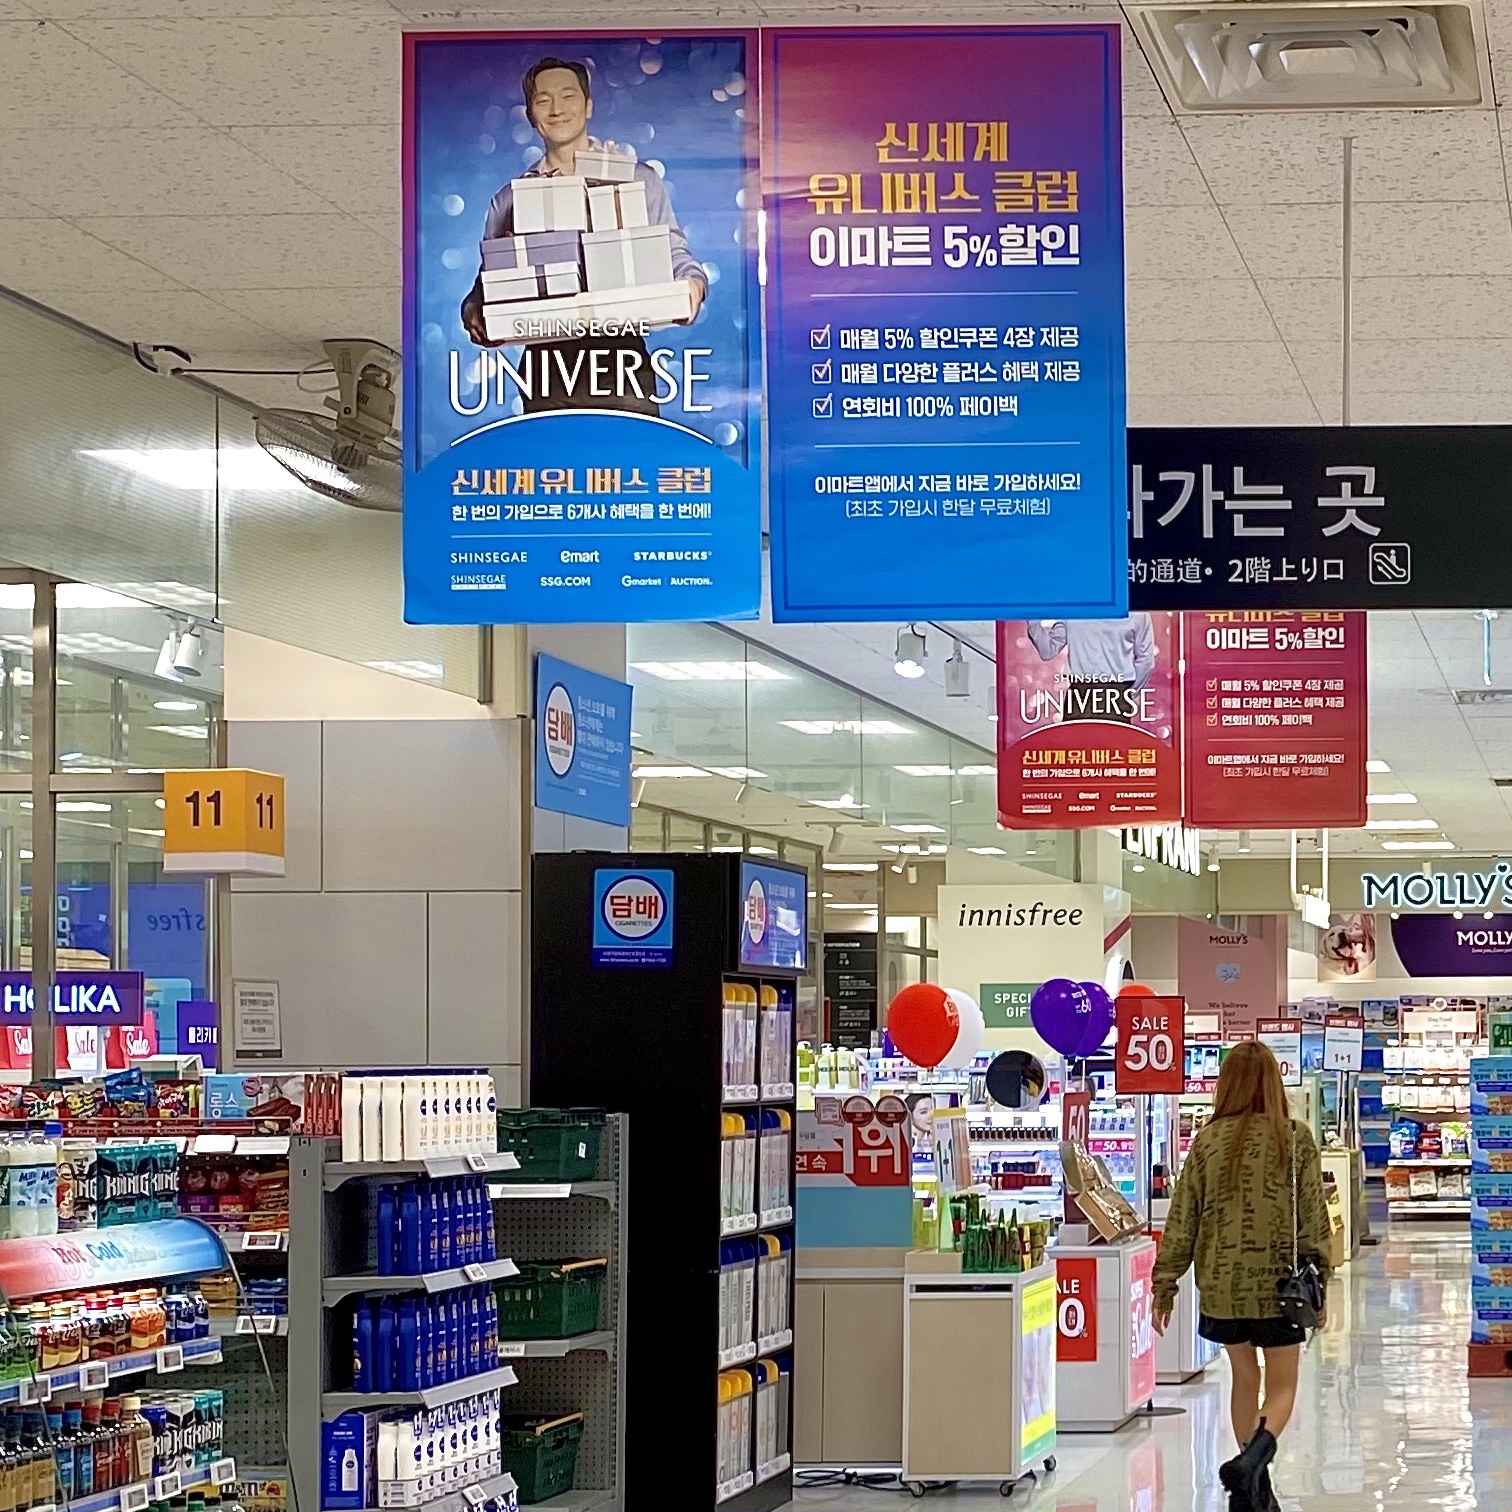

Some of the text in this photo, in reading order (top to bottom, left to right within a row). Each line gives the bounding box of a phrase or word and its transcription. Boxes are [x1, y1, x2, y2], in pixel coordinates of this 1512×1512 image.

[875, 122, 1008, 163] 신세계
[807, 170, 1079, 215] 유니버스 클럽
[810, 224, 1080, 268] 이마트 5%할인
[514, 318, 650, 337] SHINSEGAE
[840, 326, 1080, 350] 매월 5% 할인쿠폰 4장 제공
[450, 348, 713, 416] UNIVERSE
[841, 361, 1080, 384] 매월 다양한 플러스 혜택 제공
[842, 396, 1018, 418] 연회비 100% 페이백
[451, 466, 712, 495] 신세계 유니버스 클럽
[815, 473, 1081, 493] 이마트앱에서 지금 바로 가입하세요!
[451, 505, 467, 521] 한
[471, 505, 501, 521] 번의
[504, 504, 564, 520] 가입으로
[658, 503, 674, 519] 한
[888, 499, 937, 517] 가입시
[943, 498, 975, 516] 한달
[1318, 466, 1385, 537] 곳
[451, 551, 528, 564] SHINSEGAE
[560, 549, 600, 563] emart
[451, 575, 506, 584] SHINSEGAE
[540, 576, 591, 587] SSG.COM
[622, 575, 662, 587] Gmarket
[1206, 628, 1269, 649] 이마트
[1054, 673, 1124, 684] SHINSEGAE
[1244, 681, 1260, 690] 5%
[1020, 688, 1156, 724] UNIVERSE
[548, 707, 573, 746] 담배
[1254, 715, 1279, 725] 100%
[1127, 749, 1156, 764] 클럽
[185, 790, 222, 827] 11
[255, 791, 274, 830] 11
[609, 895, 659, 919] 담배
[959, 902, 1083, 926] innisfree
[1209, 933, 1248, 945] MOLLY'S
[1006, 1007, 1031, 1018] GIF
[1132, 1017, 1169, 1031] SALE
[14, 1029, 32, 1056] Sal
[126, 1031, 150, 1056] Sale
[1124, 1034, 1173, 1071] 50
[1334, 1053, 1351, 1064] 1+1
[210, 1092, 241, 1118] 롱스
[833, 1122, 901, 1174] 1위
[52, 1240, 121, 1264] Hot Cold
